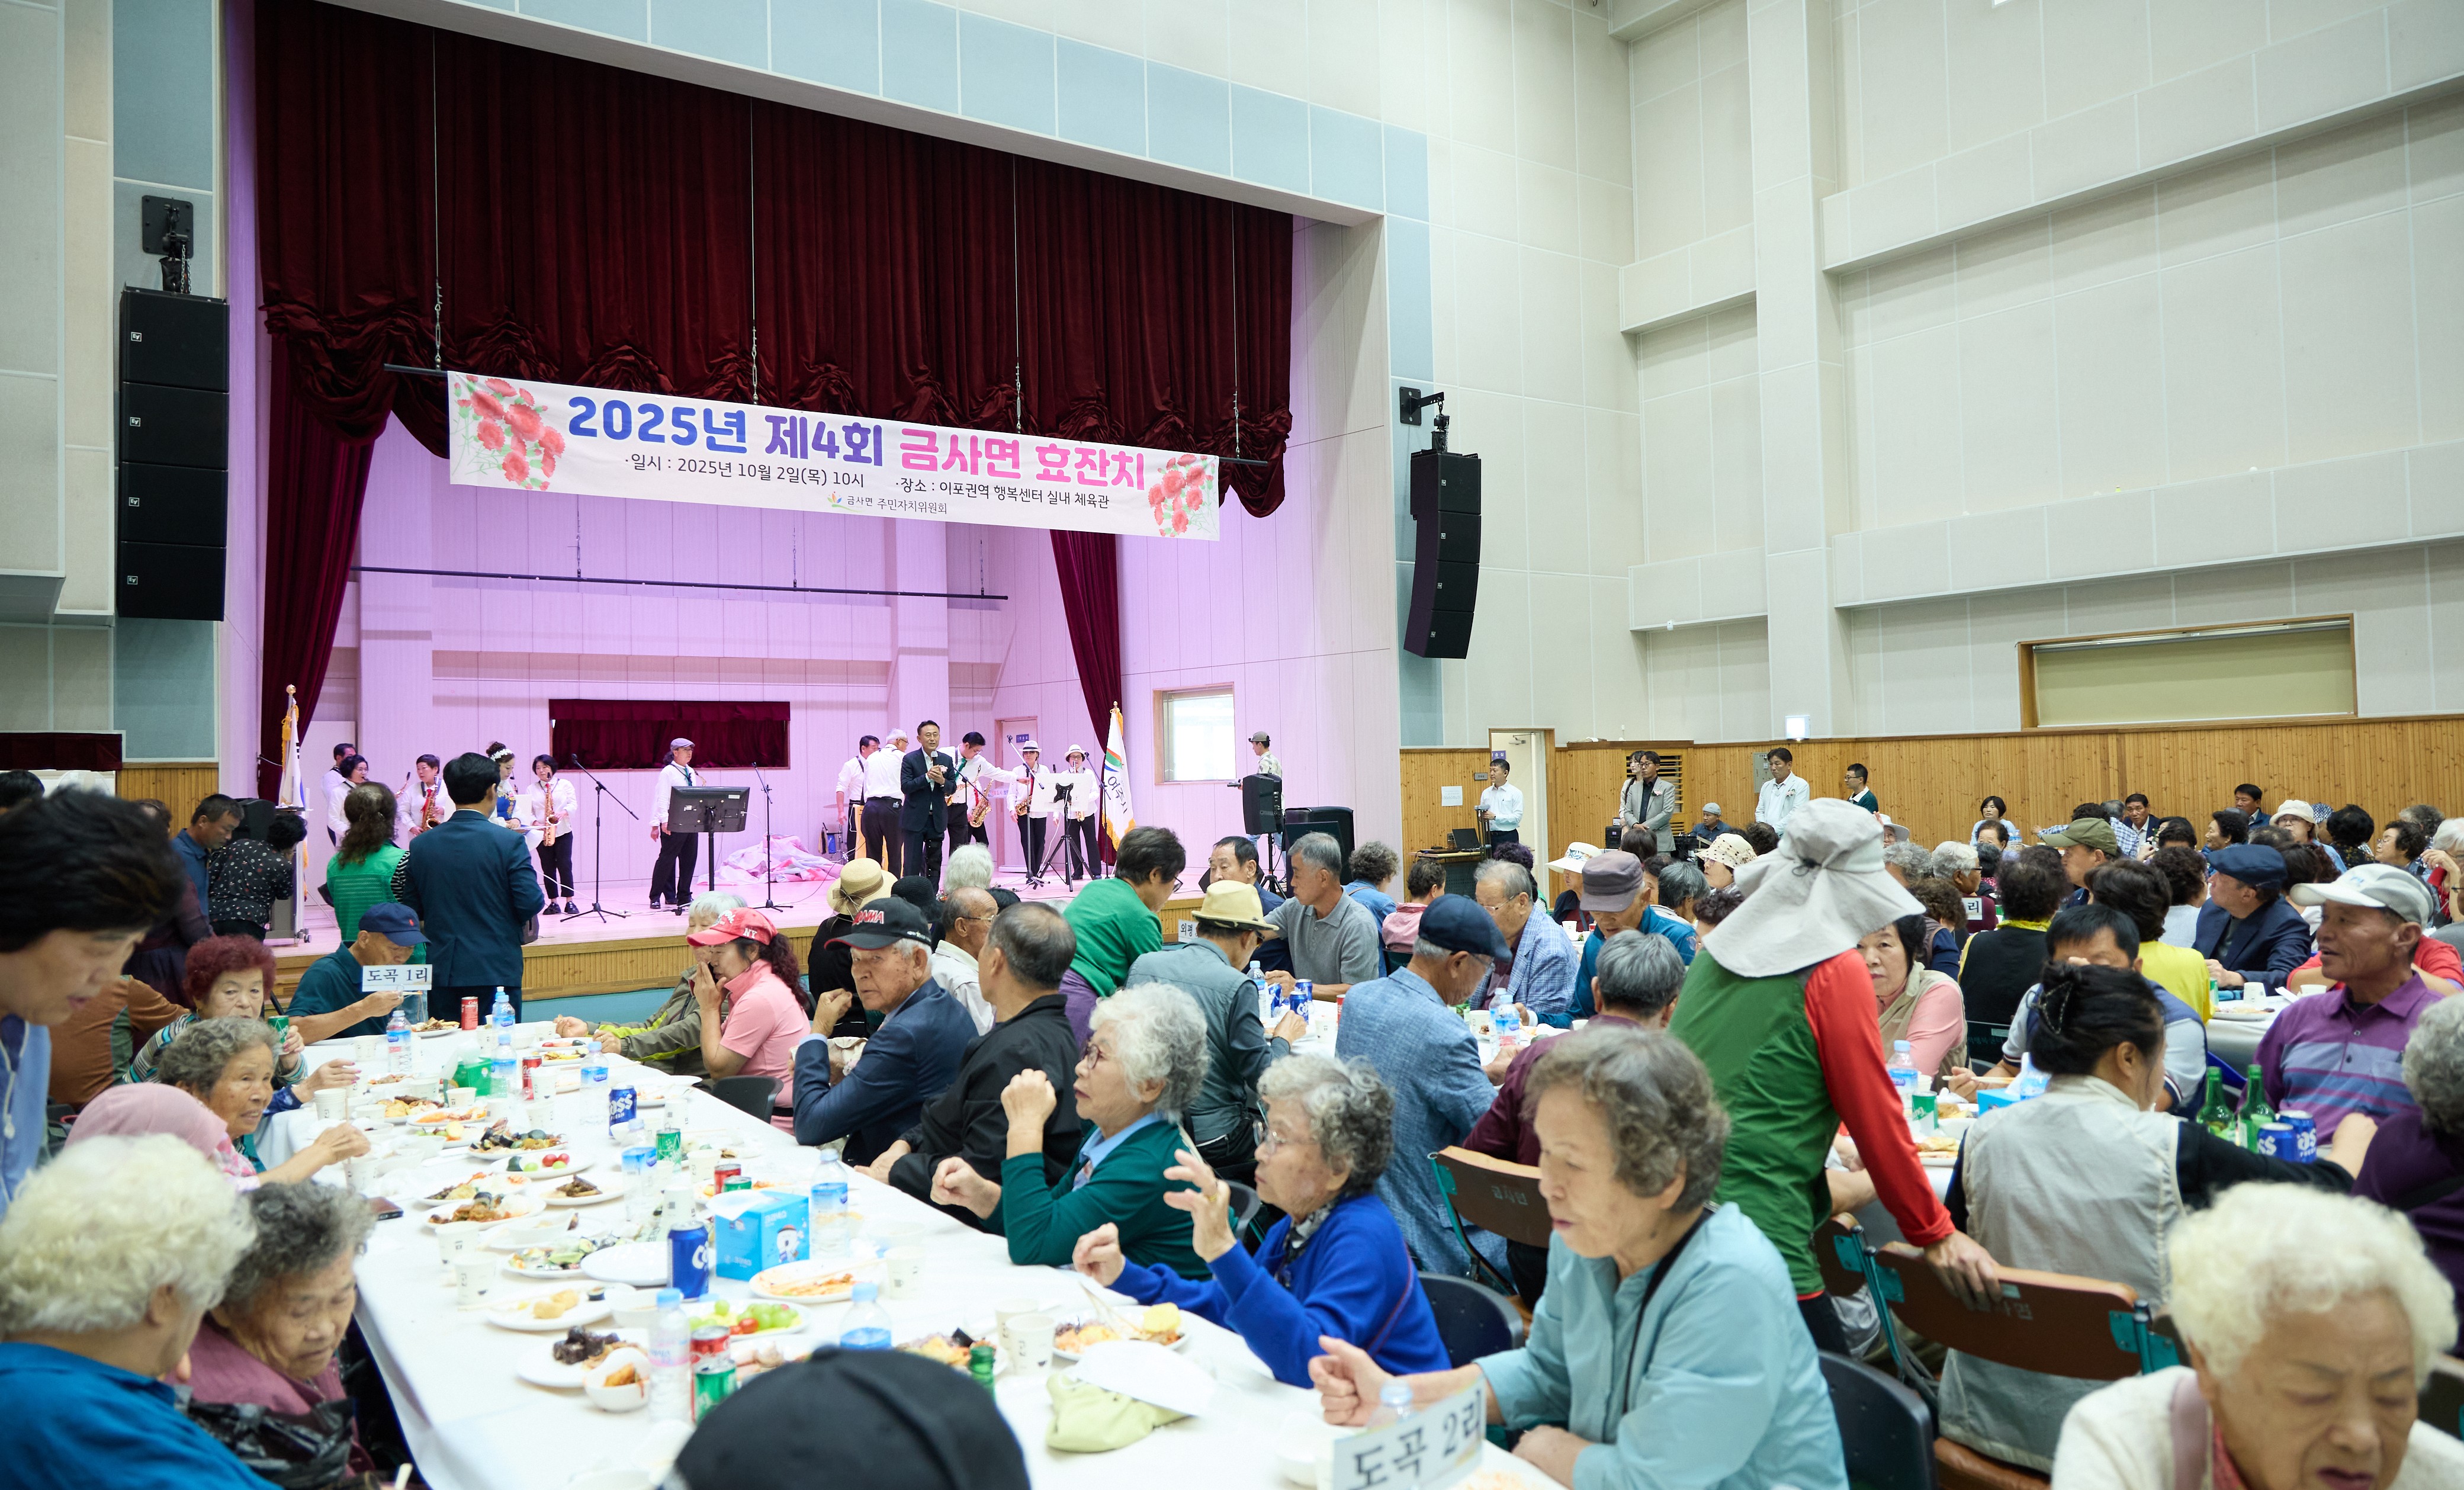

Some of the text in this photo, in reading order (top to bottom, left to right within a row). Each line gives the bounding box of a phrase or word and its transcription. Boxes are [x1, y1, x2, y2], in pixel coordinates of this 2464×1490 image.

[568, 396, 1145, 490] 2025년 제4회 금사면 효잔치
[678, 458, 732, 477] 2025년
[738, 464, 771, 481] 10월
[777, 467, 827, 486] 2일(목)
[833, 472, 864, 487] 10시
[847, 496, 947, 514] 금사면 주민자치위원회
[940, 482, 990, 499] 이포권역
[994, 485, 1043, 503] 행복센터
[1047, 491, 1071, 505] 실내
[1075, 493, 1110, 509] 체육관
[743, 927, 757, 939] NY
[1180, 923, 1193, 937] 외평
[367, 967, 428, 983] 도곡 1리
[609, 1093, 633, 1116] ass
[1349, 1389, 1482, 1490] 도곡 2리
